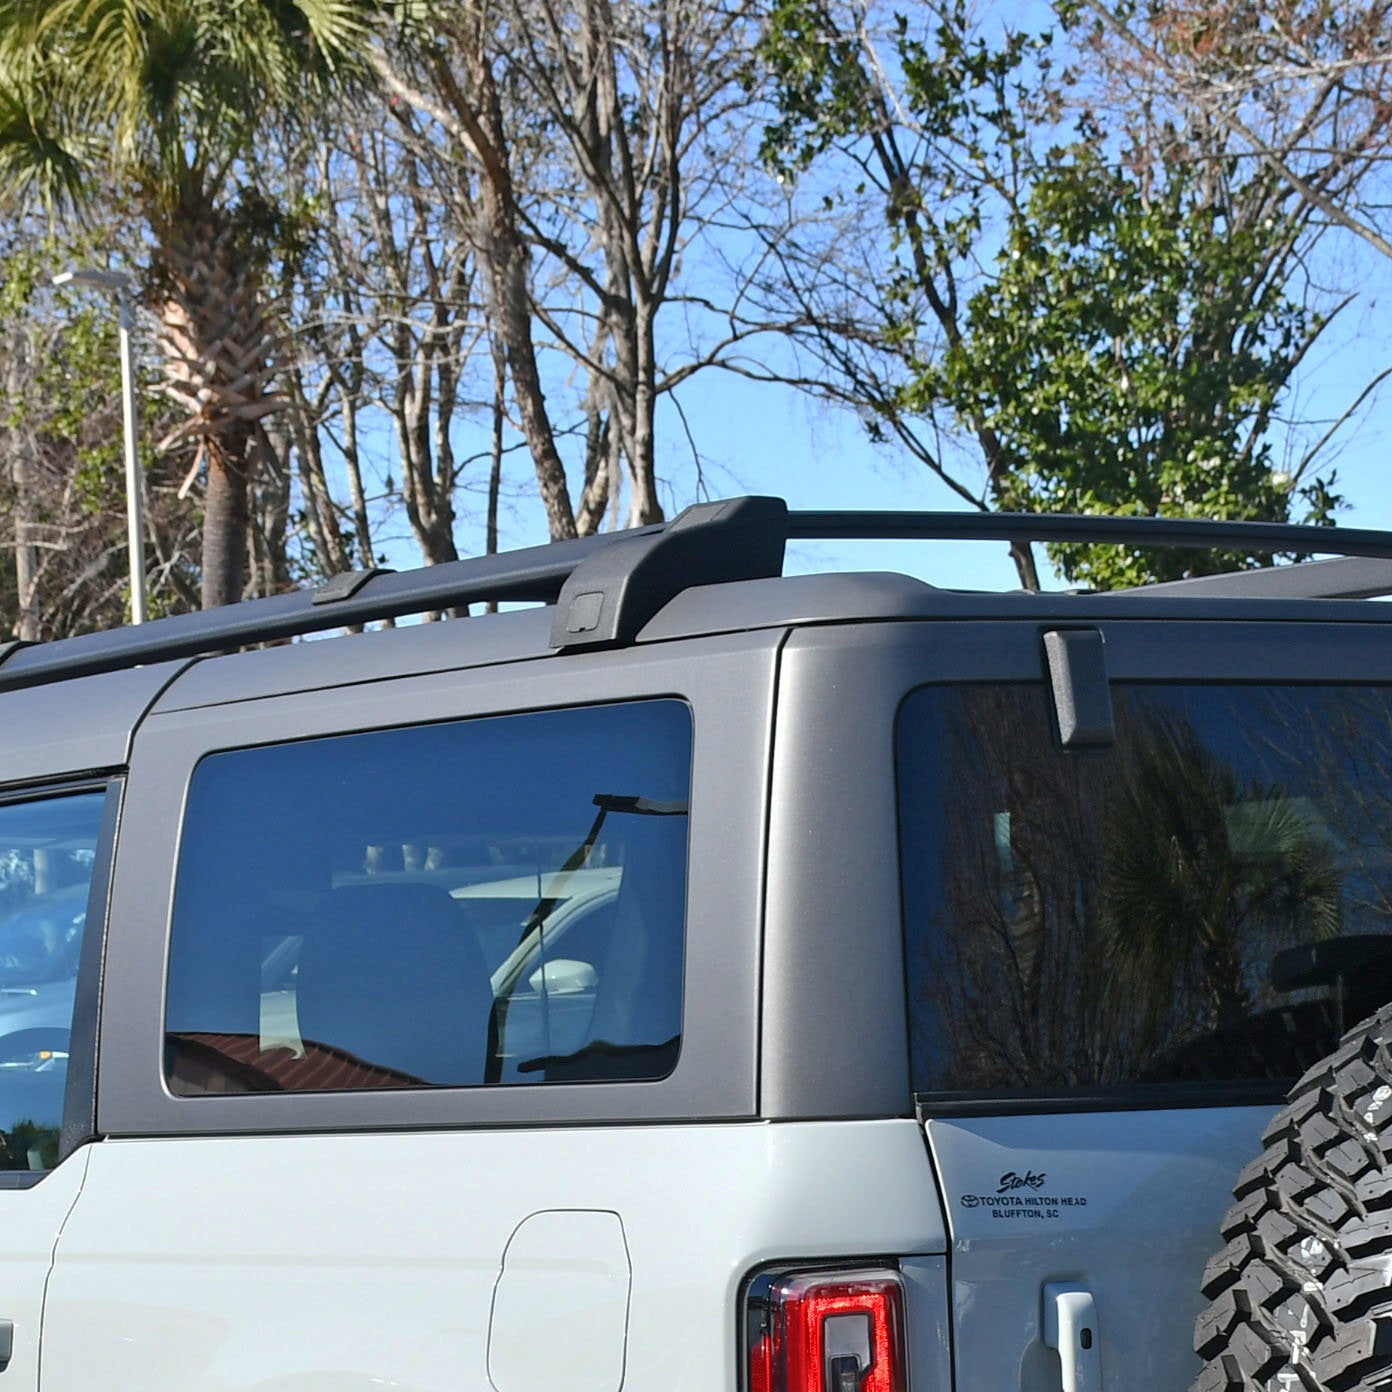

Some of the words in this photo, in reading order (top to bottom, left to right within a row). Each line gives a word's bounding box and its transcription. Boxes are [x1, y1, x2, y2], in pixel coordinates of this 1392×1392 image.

[995, 1169, 1047, 1194] Stokes
[980, 1196, 1023, 1207] TOYOTA
[1024, 1196, 1059, 1207] HILTON
[1061, 1196, 1087, 1207] HEAD
[992, 1209, 1044, 1219] BLUFFTON,
[1046, 1209, 1060, 1218] SC
